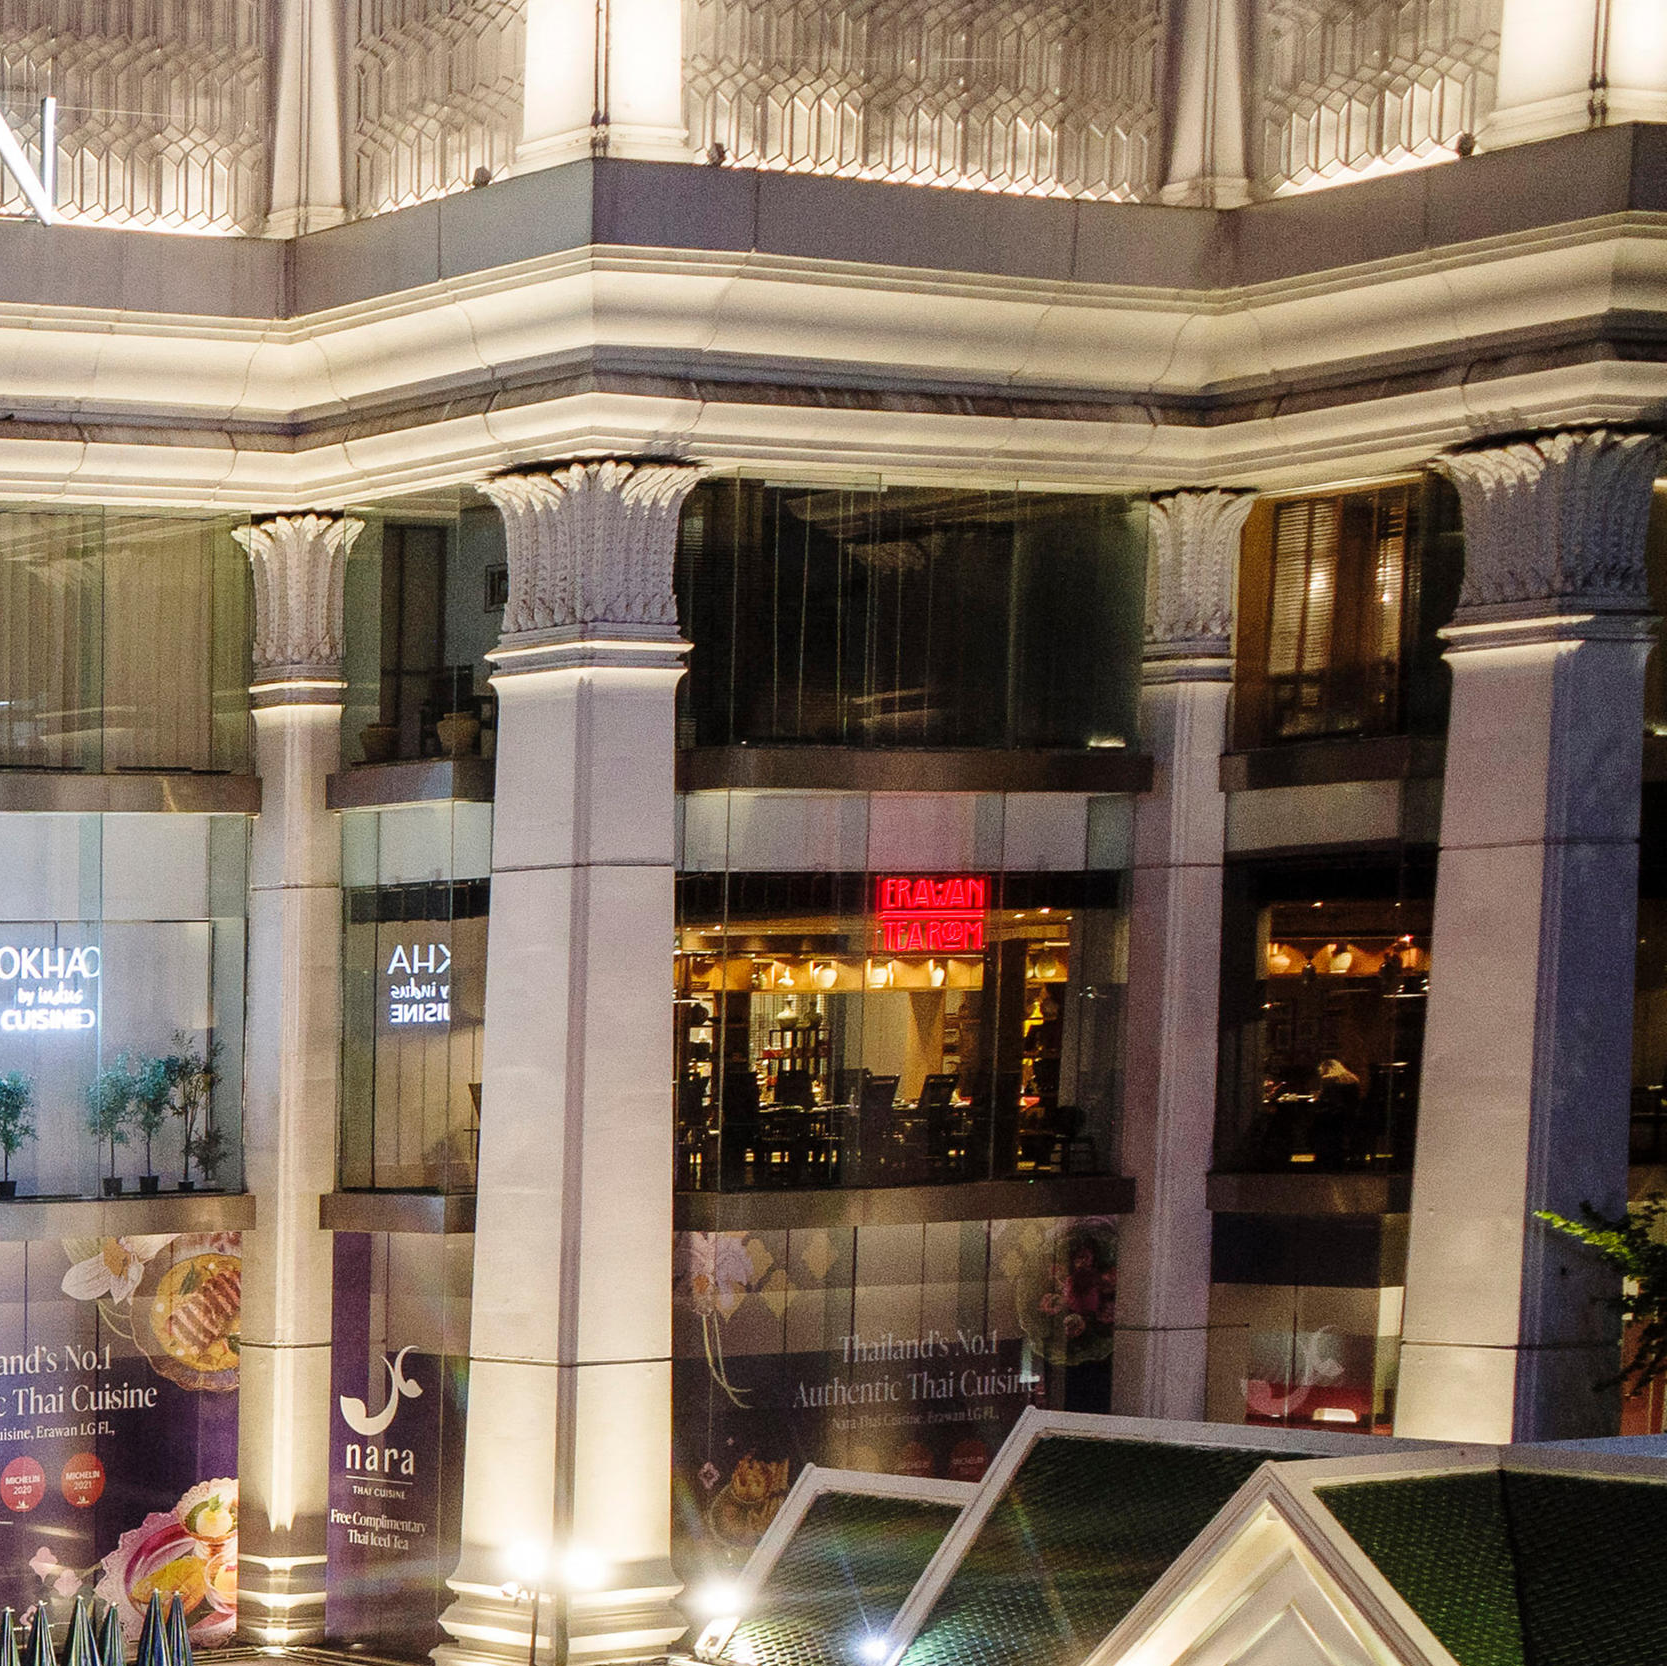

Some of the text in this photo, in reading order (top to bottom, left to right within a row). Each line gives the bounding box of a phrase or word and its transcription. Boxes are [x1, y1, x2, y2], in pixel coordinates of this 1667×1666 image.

[882, 878, 985, 909] ERAWAN
[883, 920, 984, 951] TEA ROOM
[65, 1343, 112, 1371] No.1
[12, 1385, 64, 1416] Thai
[71, 1382, 158, 1412] Cuisine
[793, 1376, 903, 1409] Authentic
[907, 1371, 954, 1400] Thai
[37, 1425, 78, 1438] Erawan
[80, 1423, 96, 1435] LG
[345, 1443, 415, 1475] nara
[5, 1474, 41, 1485] MICHELIN
[65, 1470, 100, 1480] MICHELIN
[352, 1485, 406, 1500] THAI CUISINE
[330, 1508, 427, 1535] Free Complimentary
[347, 1529, 409, 1550] Thai Iced Tea
